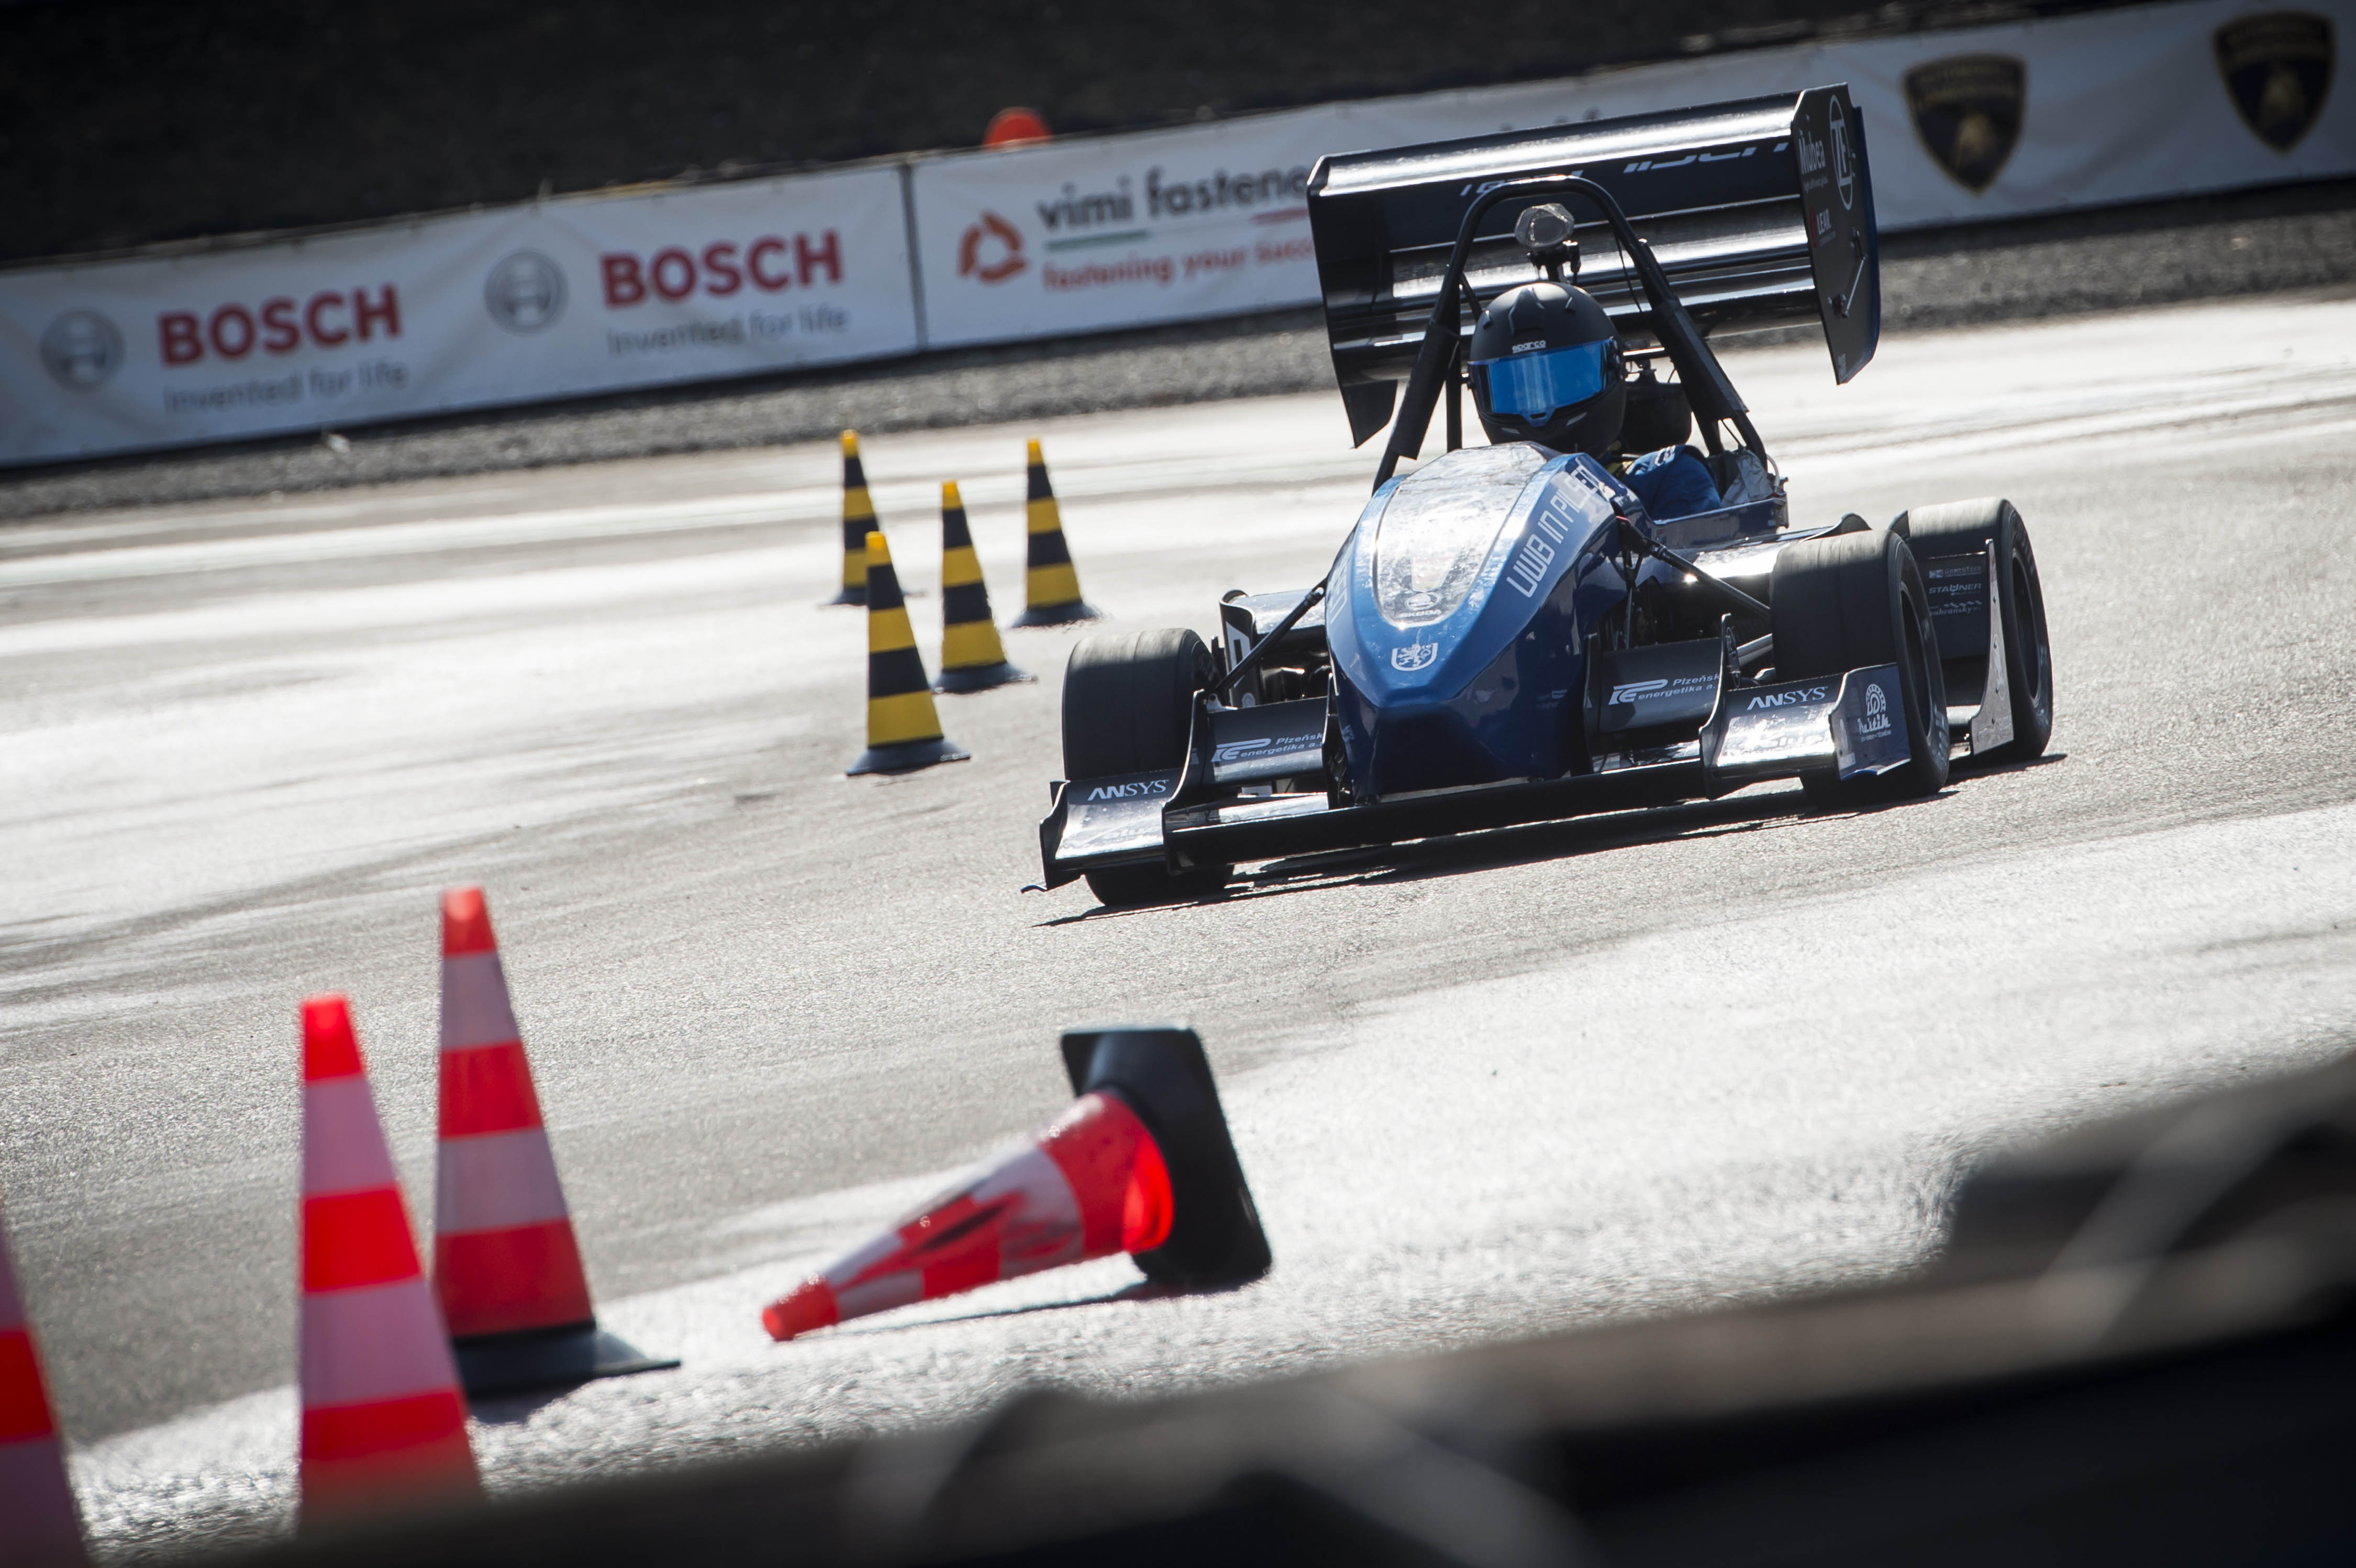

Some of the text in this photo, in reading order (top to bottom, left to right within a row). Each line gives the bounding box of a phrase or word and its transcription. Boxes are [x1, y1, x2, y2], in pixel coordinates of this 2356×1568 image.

[1798, 131, 1826, 175] Mubea
[1036, 175, 1132, 230] vimi
[601, 229, 843, 308] BOSCH
[1043, 253, 1172, 291] fastening
[1183, 246, 1245, 276] your
[158, 282, 402, 366] BOSCH
[608, 303, 848, 355] Invented for life
[1512, 340, 1546, 353] sparco
[164, 360, 408, 413] Invented for life
[1507, 533, 1555, 597] UWB
[1537, 510, 1569, 544] IN
[1929, 583, 1982, 594] STAUNER
[1638, 684, 1702, 699] energetika
[1747, 686, 1827, 711] ANSYS
[1241, 743, 1305, 758] energetika
[1087, 780, 1168, 801] ANSYS
